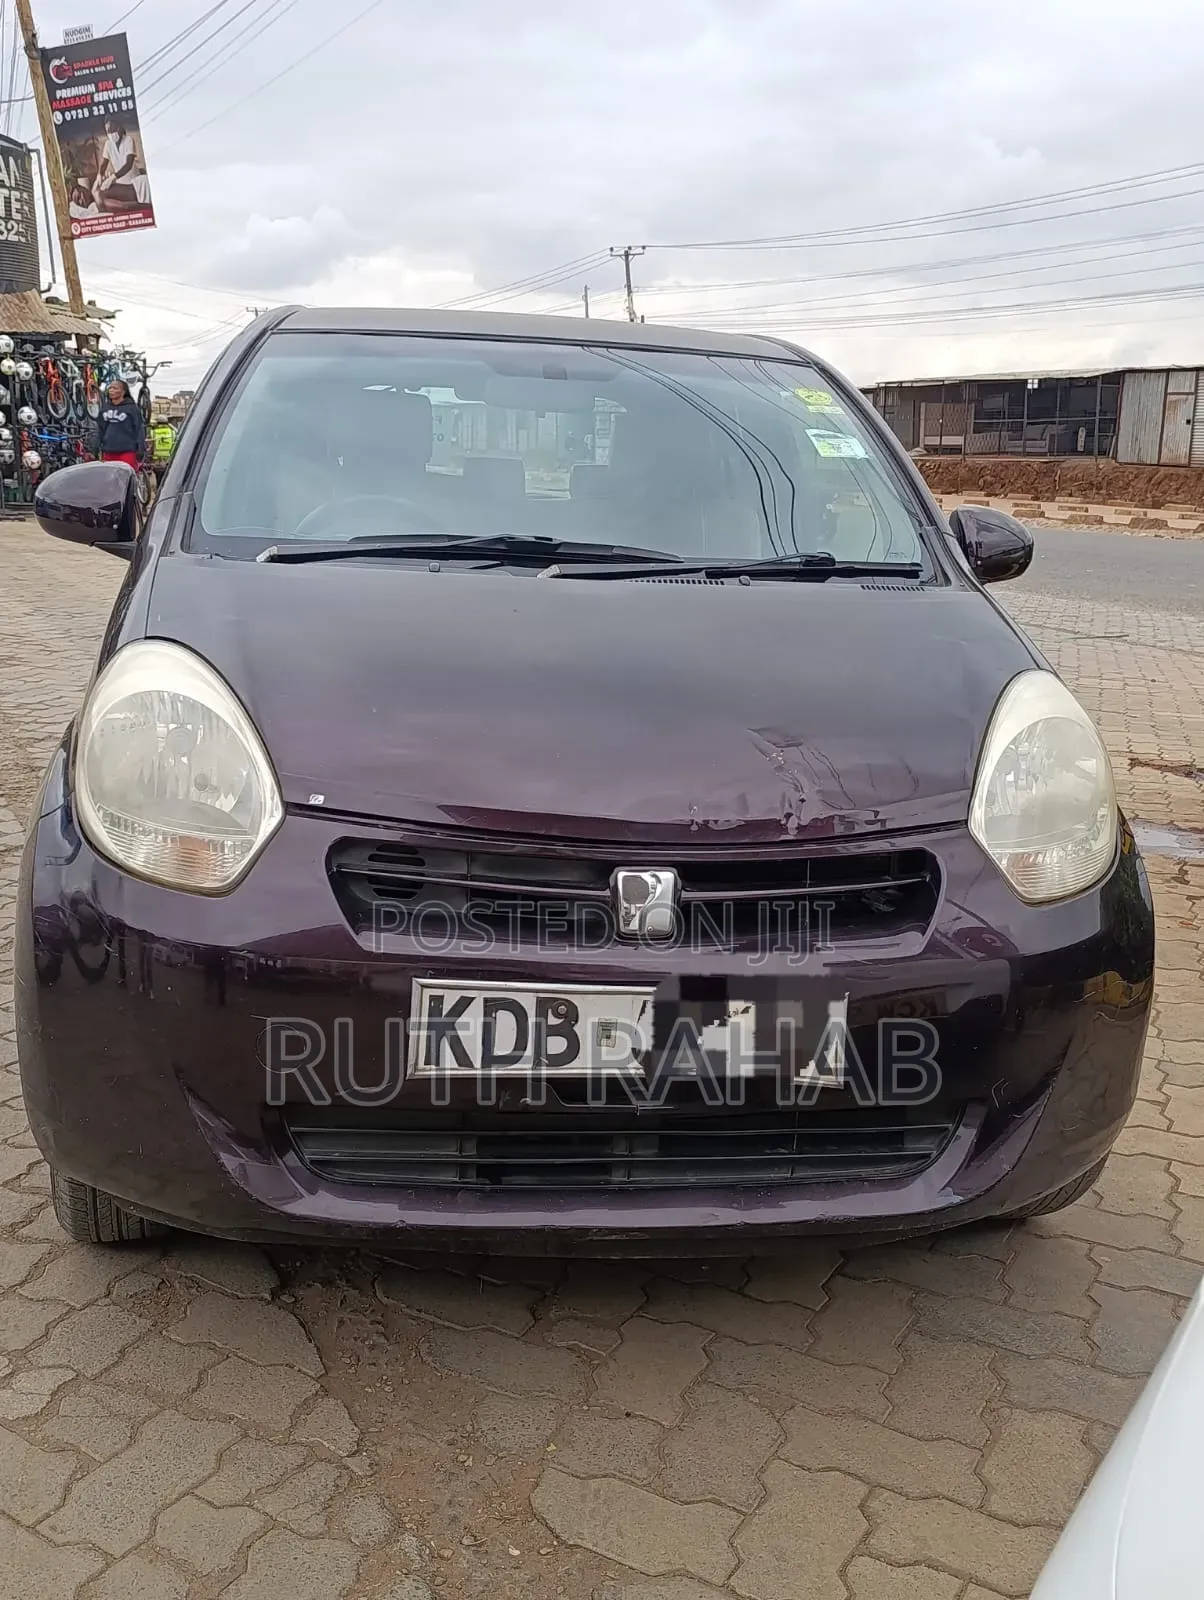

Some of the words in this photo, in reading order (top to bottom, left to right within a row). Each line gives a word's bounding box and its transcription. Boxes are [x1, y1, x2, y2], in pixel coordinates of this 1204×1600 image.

[52, 95, 92, 109] MASSAGE
[93, 86, 132, 102] SERVICES
[56, 84, 96, 99] PREMIUM
[97, 80, 114, 91] SPA
[116, 78, 123, 88] &
[102, 410, 128, 421] POLO
[424, 994, 581, 1071] KDB
